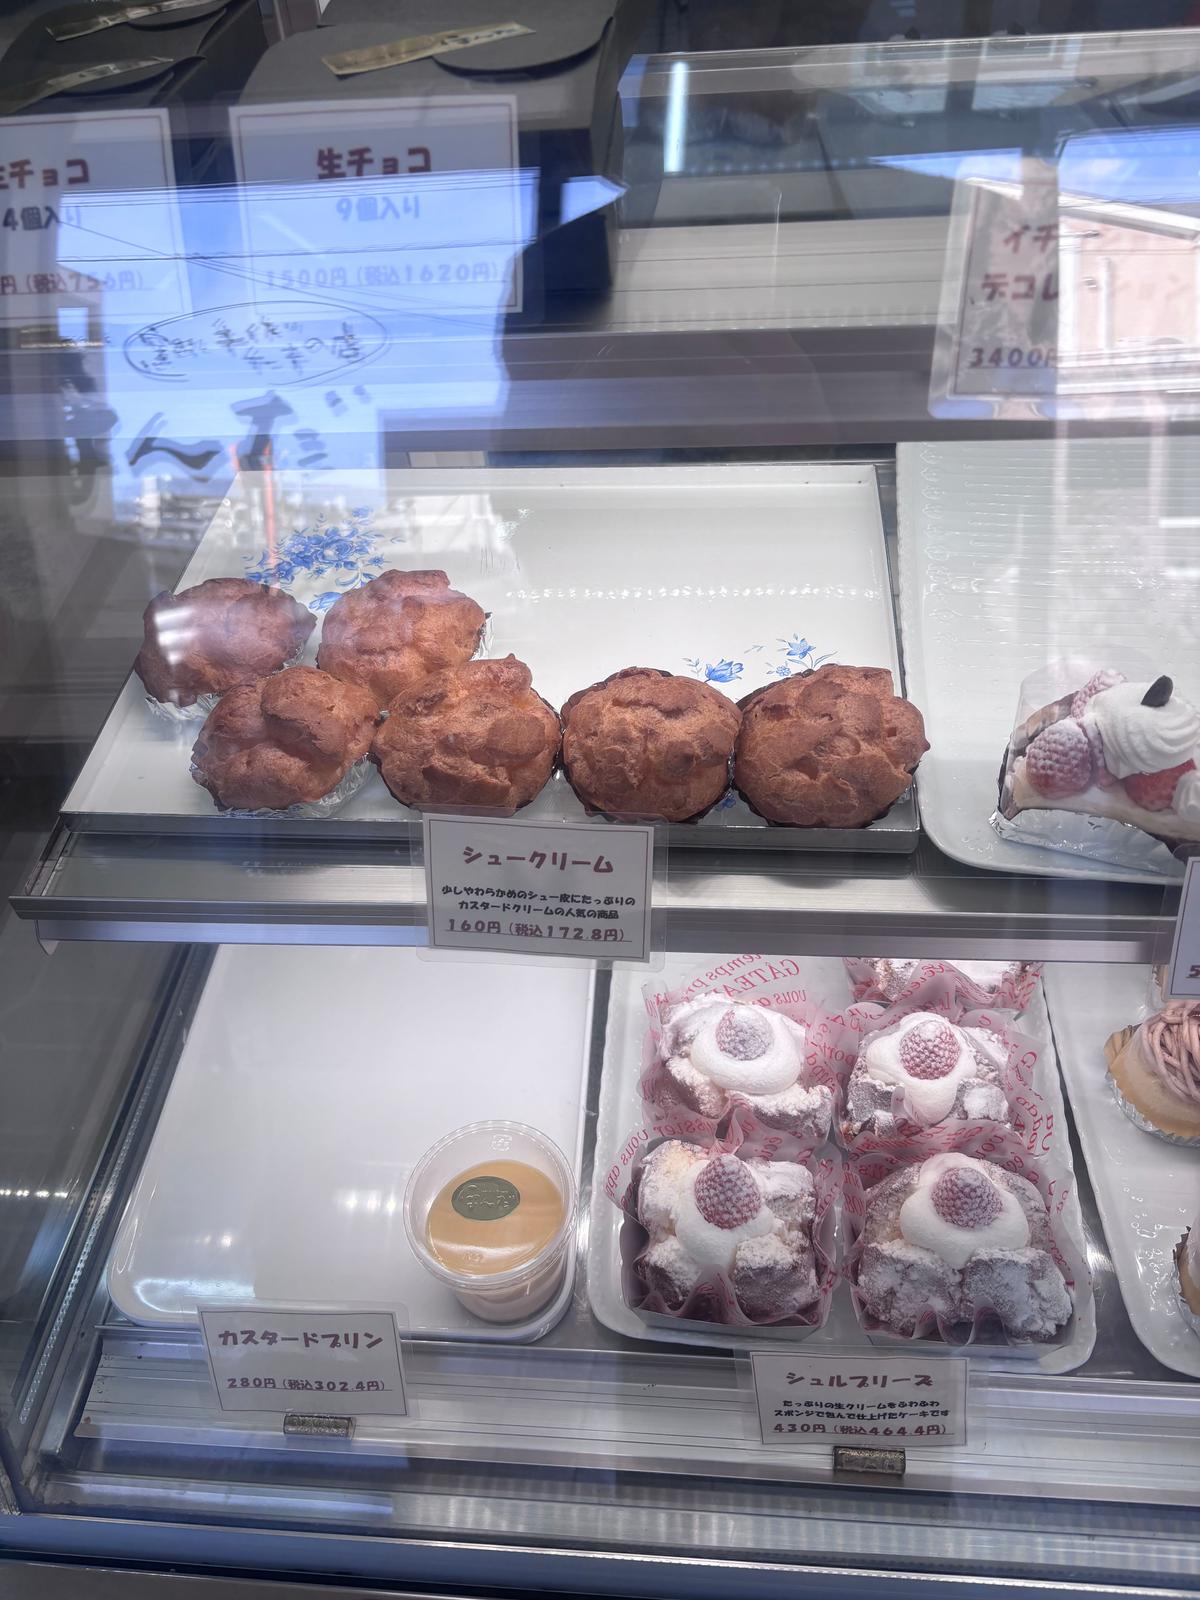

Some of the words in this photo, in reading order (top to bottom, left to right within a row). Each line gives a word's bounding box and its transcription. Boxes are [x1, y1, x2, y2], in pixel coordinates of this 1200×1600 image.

[317, 146, 433, 180] 生チョコ
[335, 195, 421, 222] 9個入り
[462, 845, 614, 874] シュークリーム
[441, 884, 636, 907] 少しやわらかめのシュー皮にたっぷりの
[458, 900, 620, 920] カスタードクリームの人気の商品
[218, 1329, 384, 1350] カスタードプリン
[785, 1371, 934, 1389] シュルプリーズ
